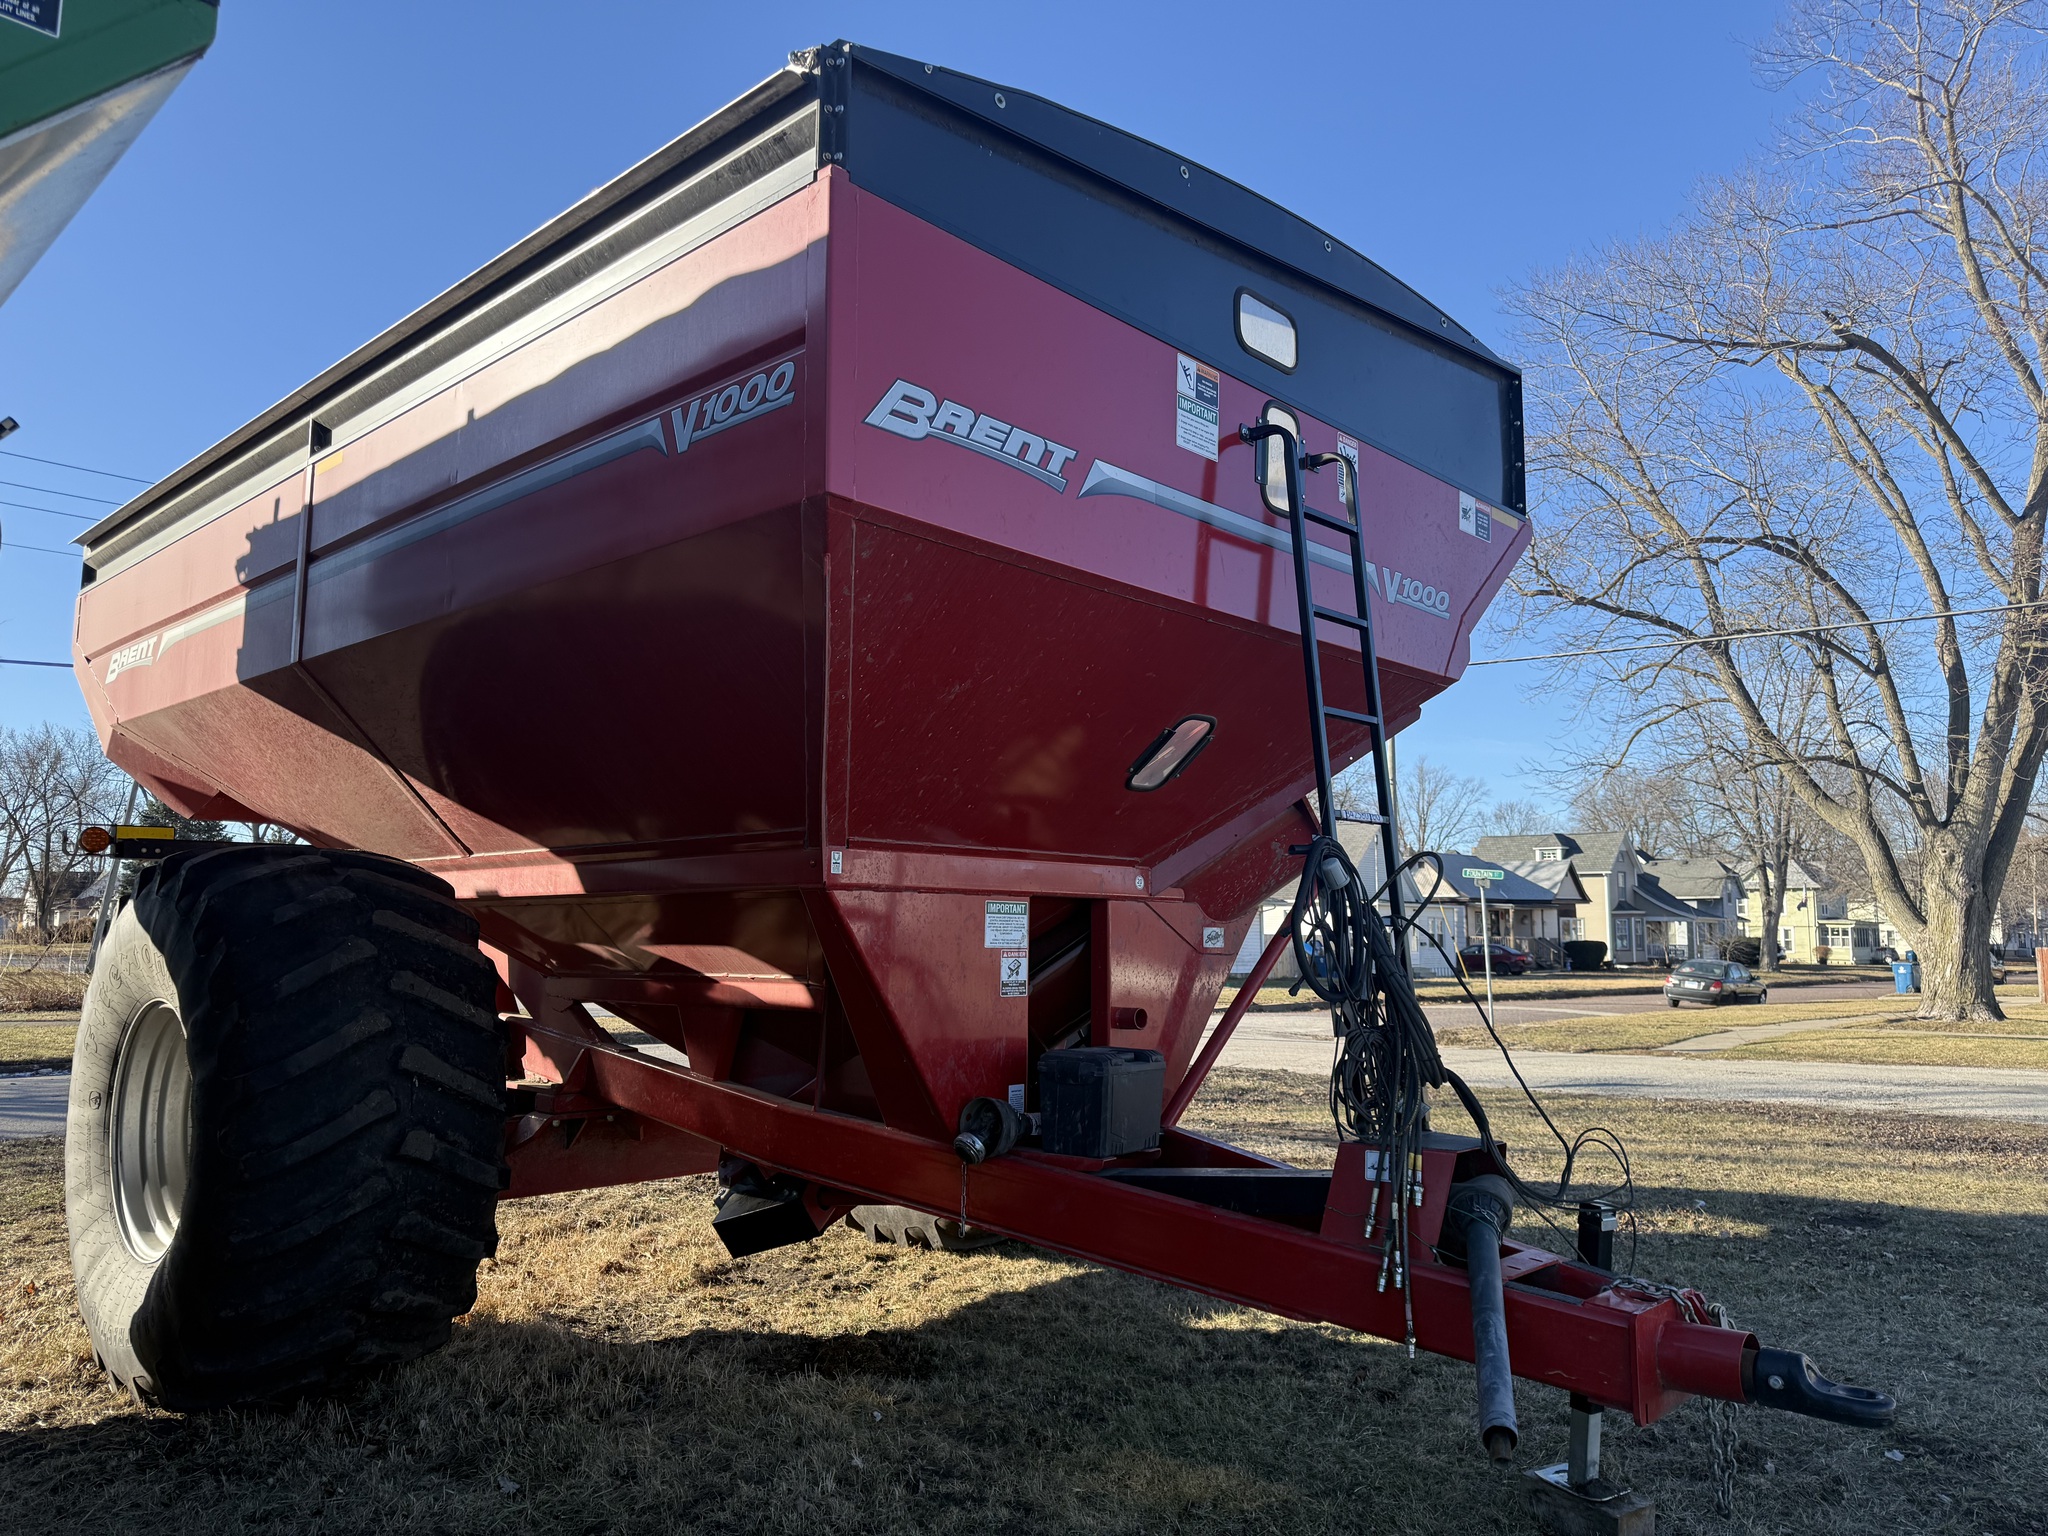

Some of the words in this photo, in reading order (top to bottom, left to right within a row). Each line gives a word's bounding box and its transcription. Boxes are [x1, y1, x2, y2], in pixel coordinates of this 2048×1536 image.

[15, 7, 37, 22] LINES.
[22, 2, 30, 10] of
[671, 361, 795, 453] V1000
[1179, 397, 1217, 424] IMPORTANT
[862, 378, 1078, 480] BRENT
[1382, 566, 1450, 613] V1000
[105, 635, 158, 685] BRENT
[987, 903, 1026, 914] IMPORTANT
